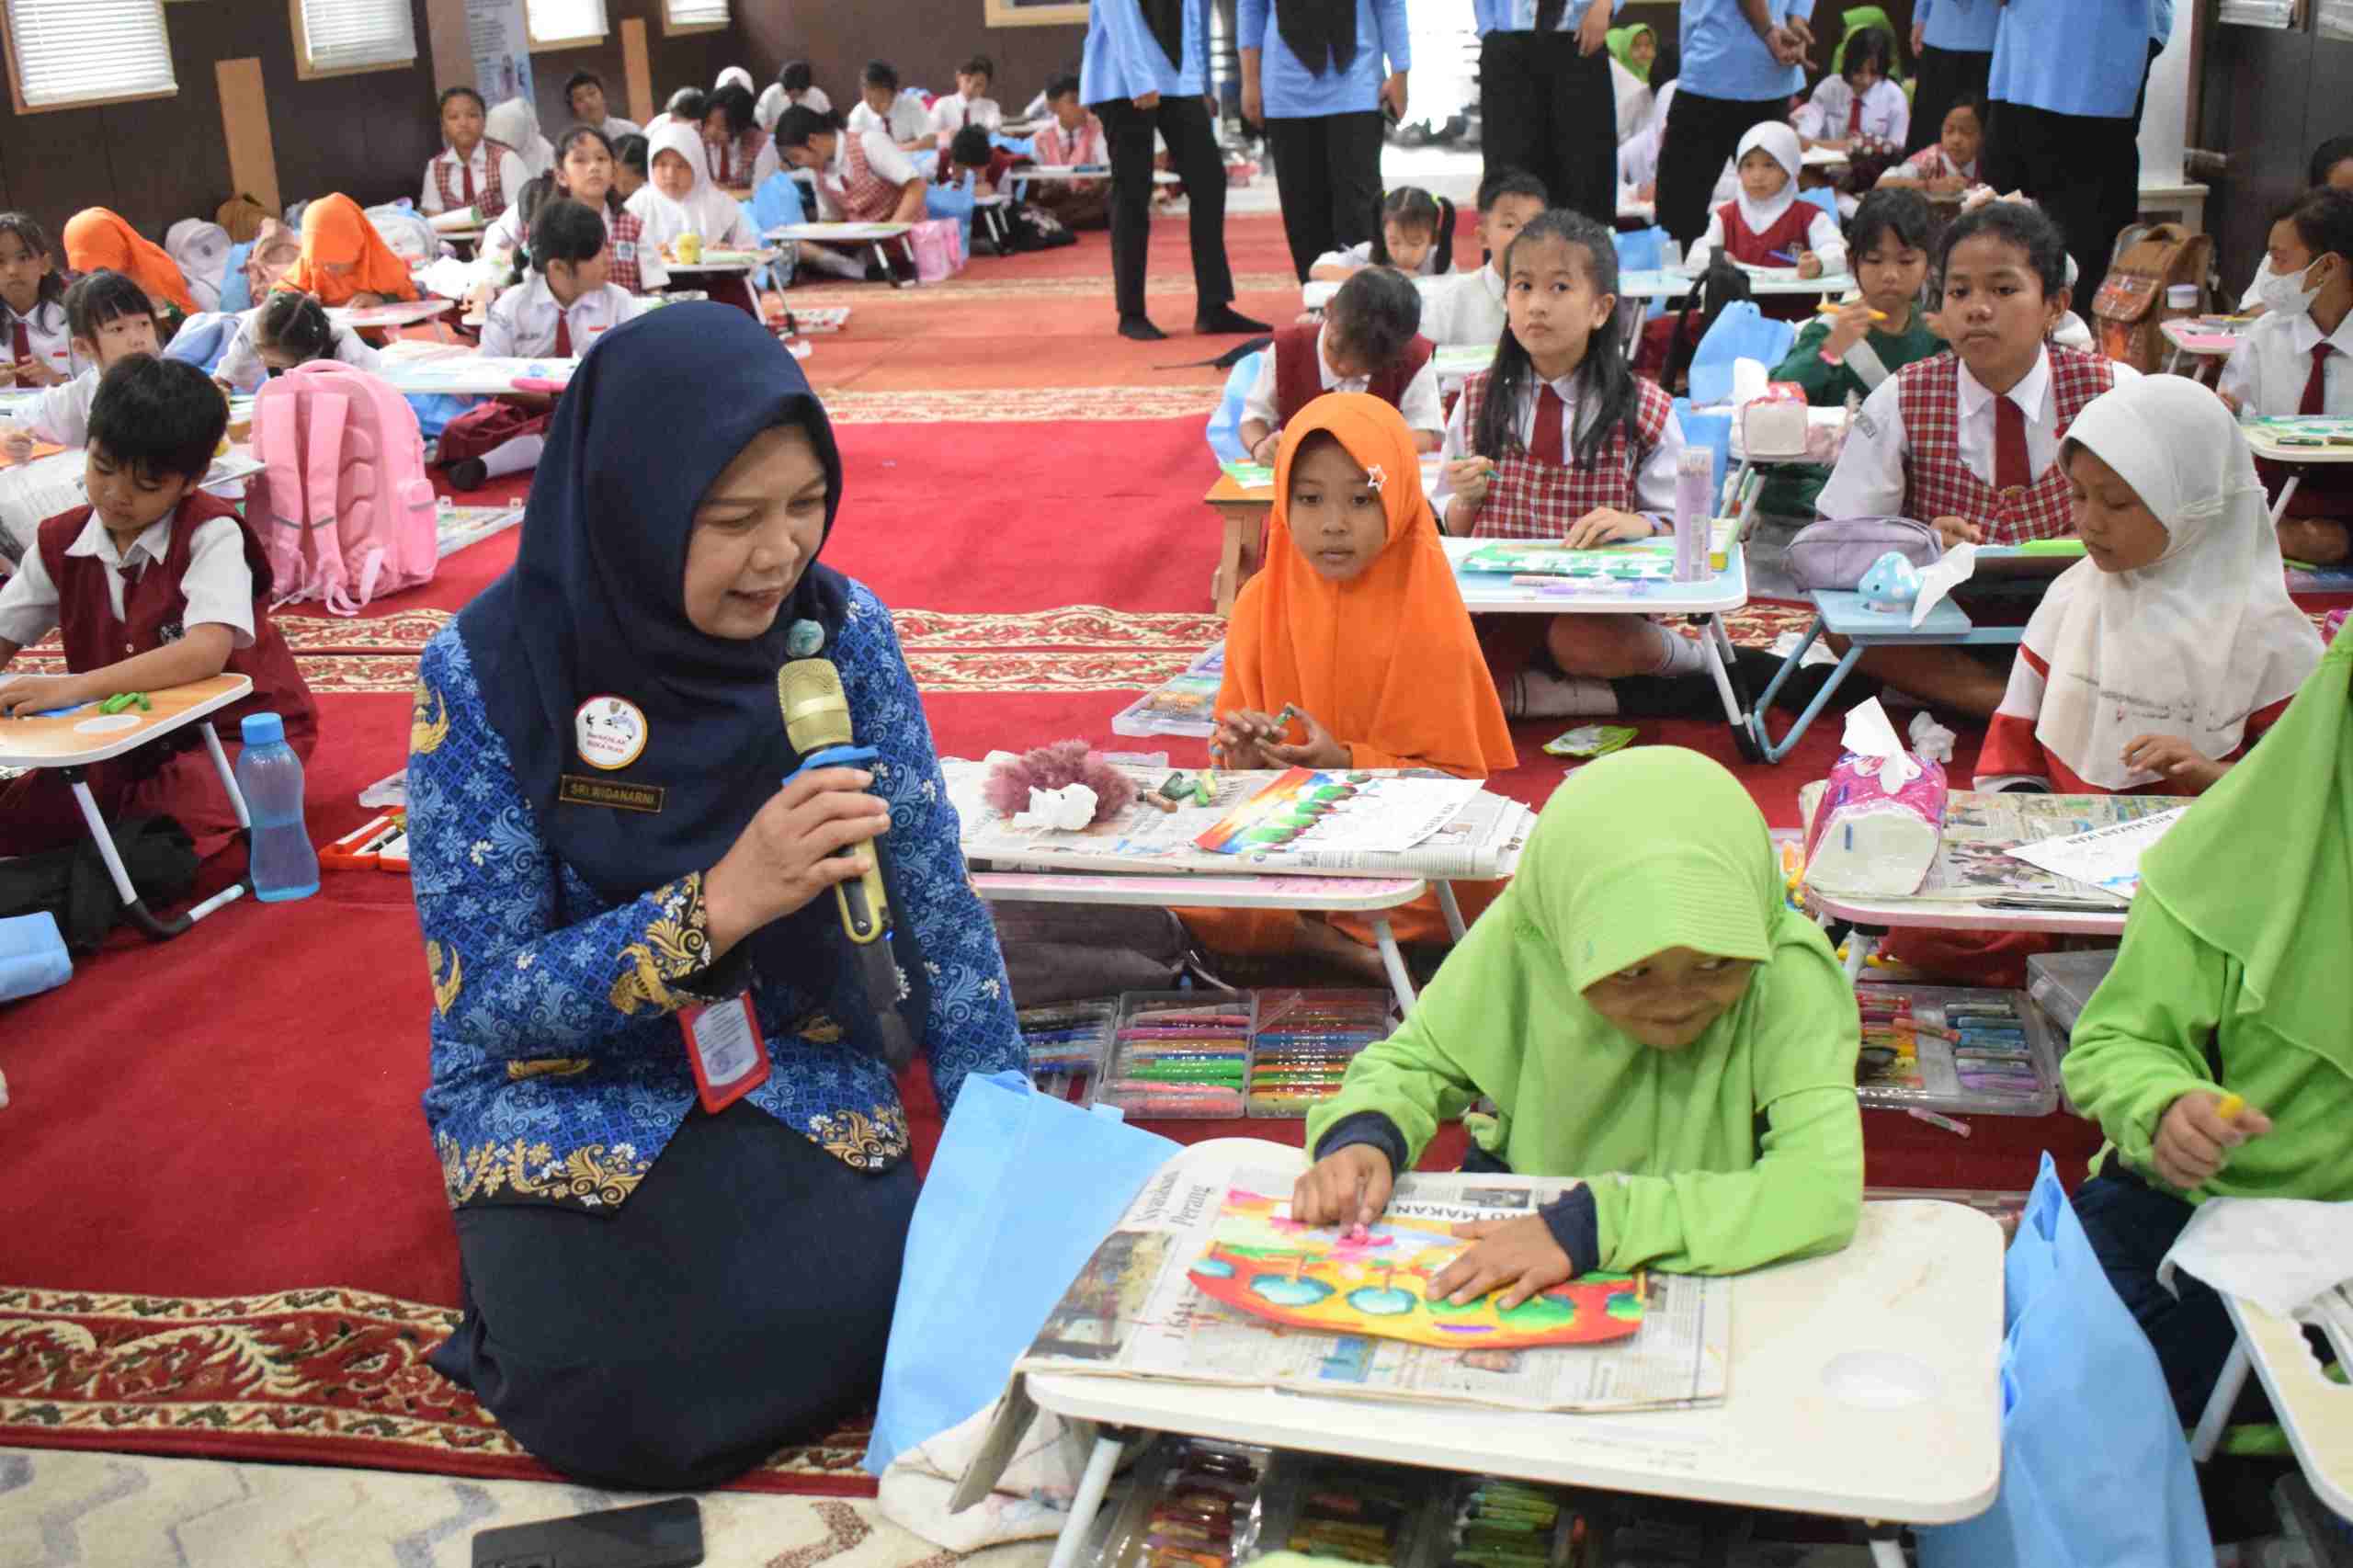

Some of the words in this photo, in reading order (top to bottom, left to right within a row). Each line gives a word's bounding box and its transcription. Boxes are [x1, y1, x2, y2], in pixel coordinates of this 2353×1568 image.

[570, 782, 589, 797] SRI
[1169, 1183, 1216, 1228] Perang
[1396, 1204, 1481, 1221] MAKAN
